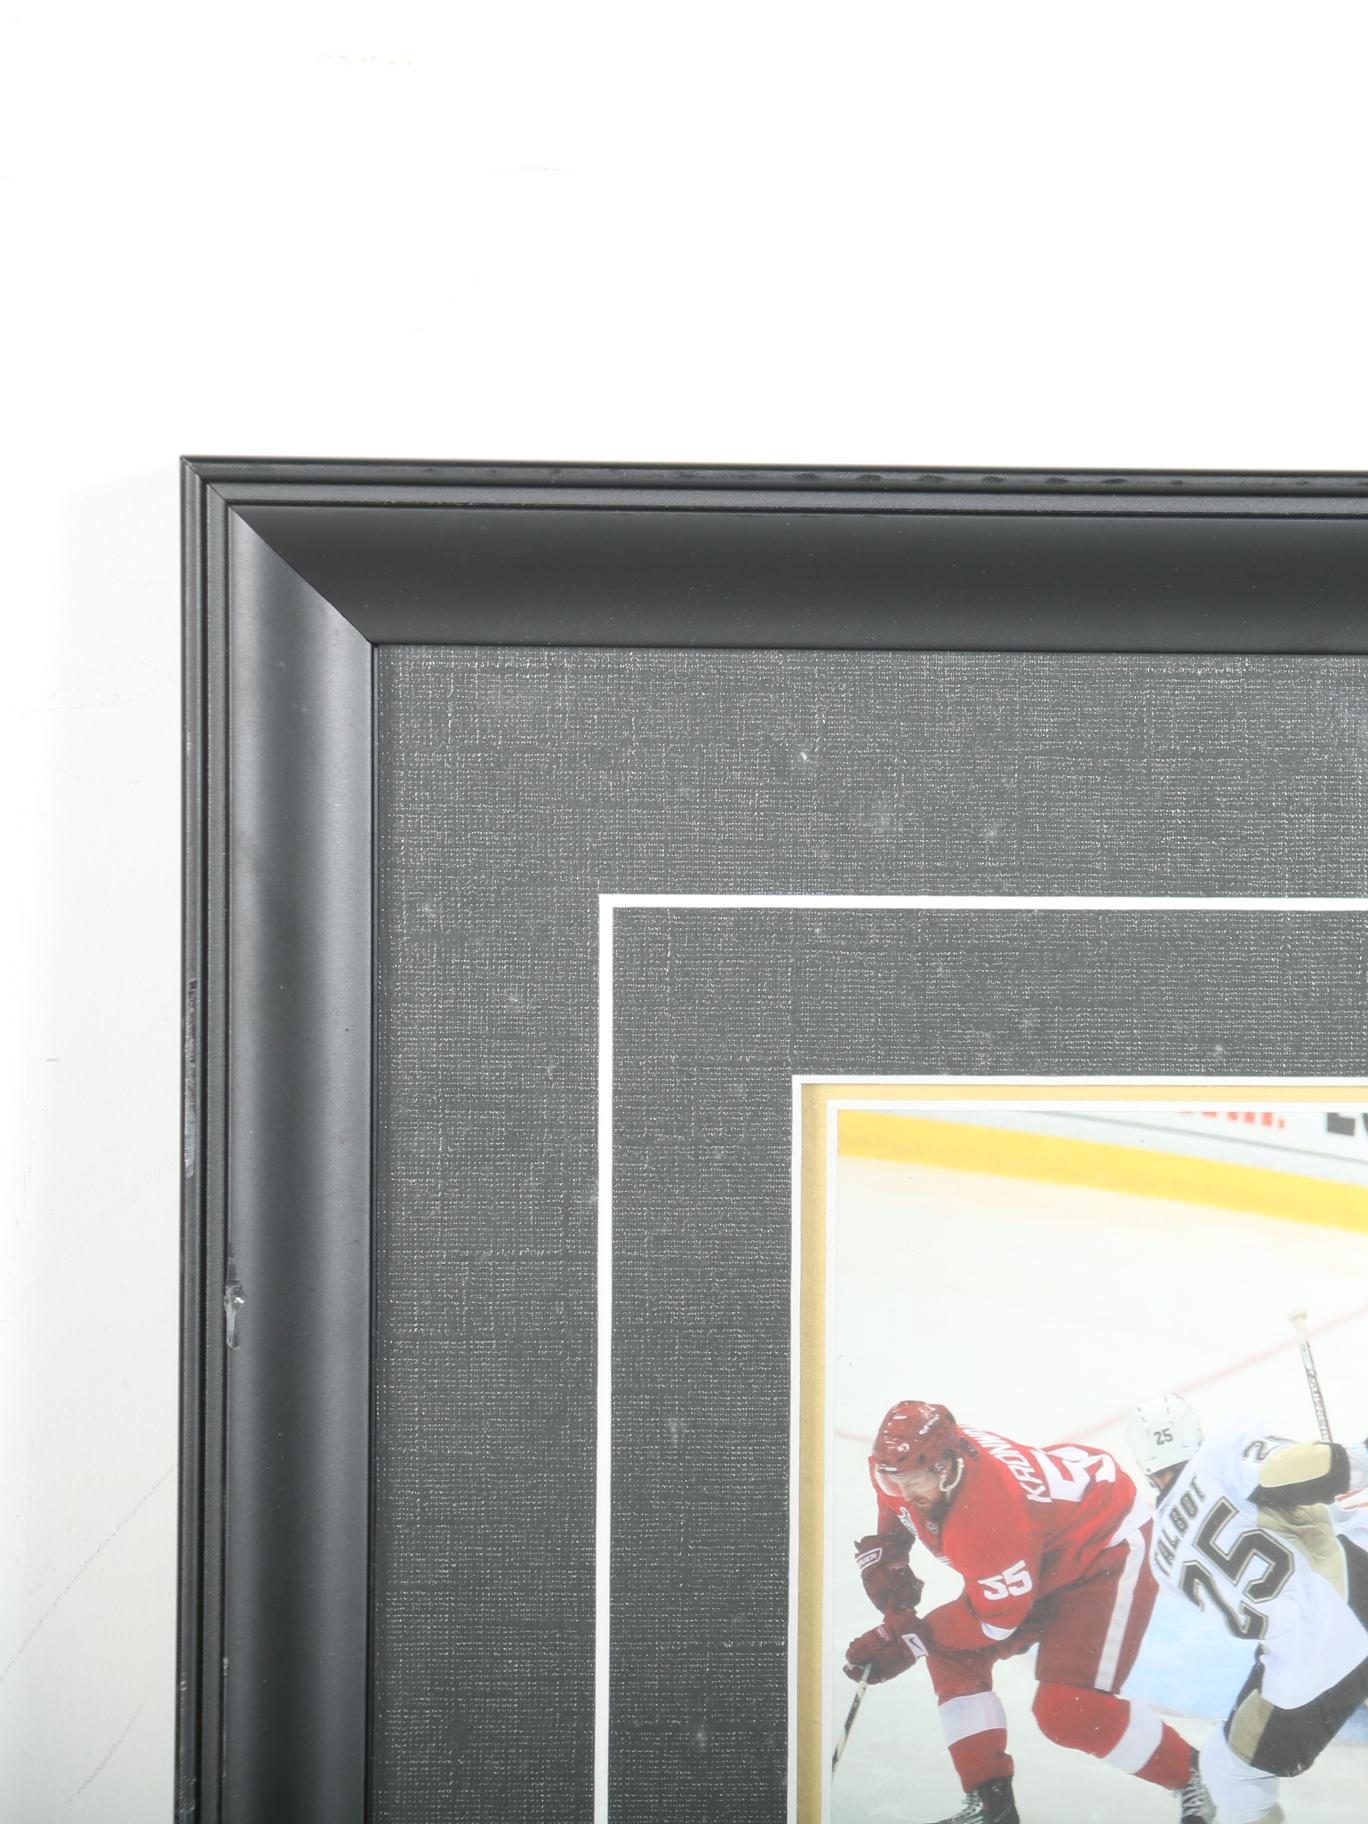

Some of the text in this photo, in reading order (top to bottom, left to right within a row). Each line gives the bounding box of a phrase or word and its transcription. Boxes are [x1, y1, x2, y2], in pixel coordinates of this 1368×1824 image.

[1154, 1427, 1174, 1447] 25
[1153, 1474, 1207, 1581] TALBOT
[977, 1559, 1033, 1601] 55
[1178, 1495, 1296, 1641] 25
